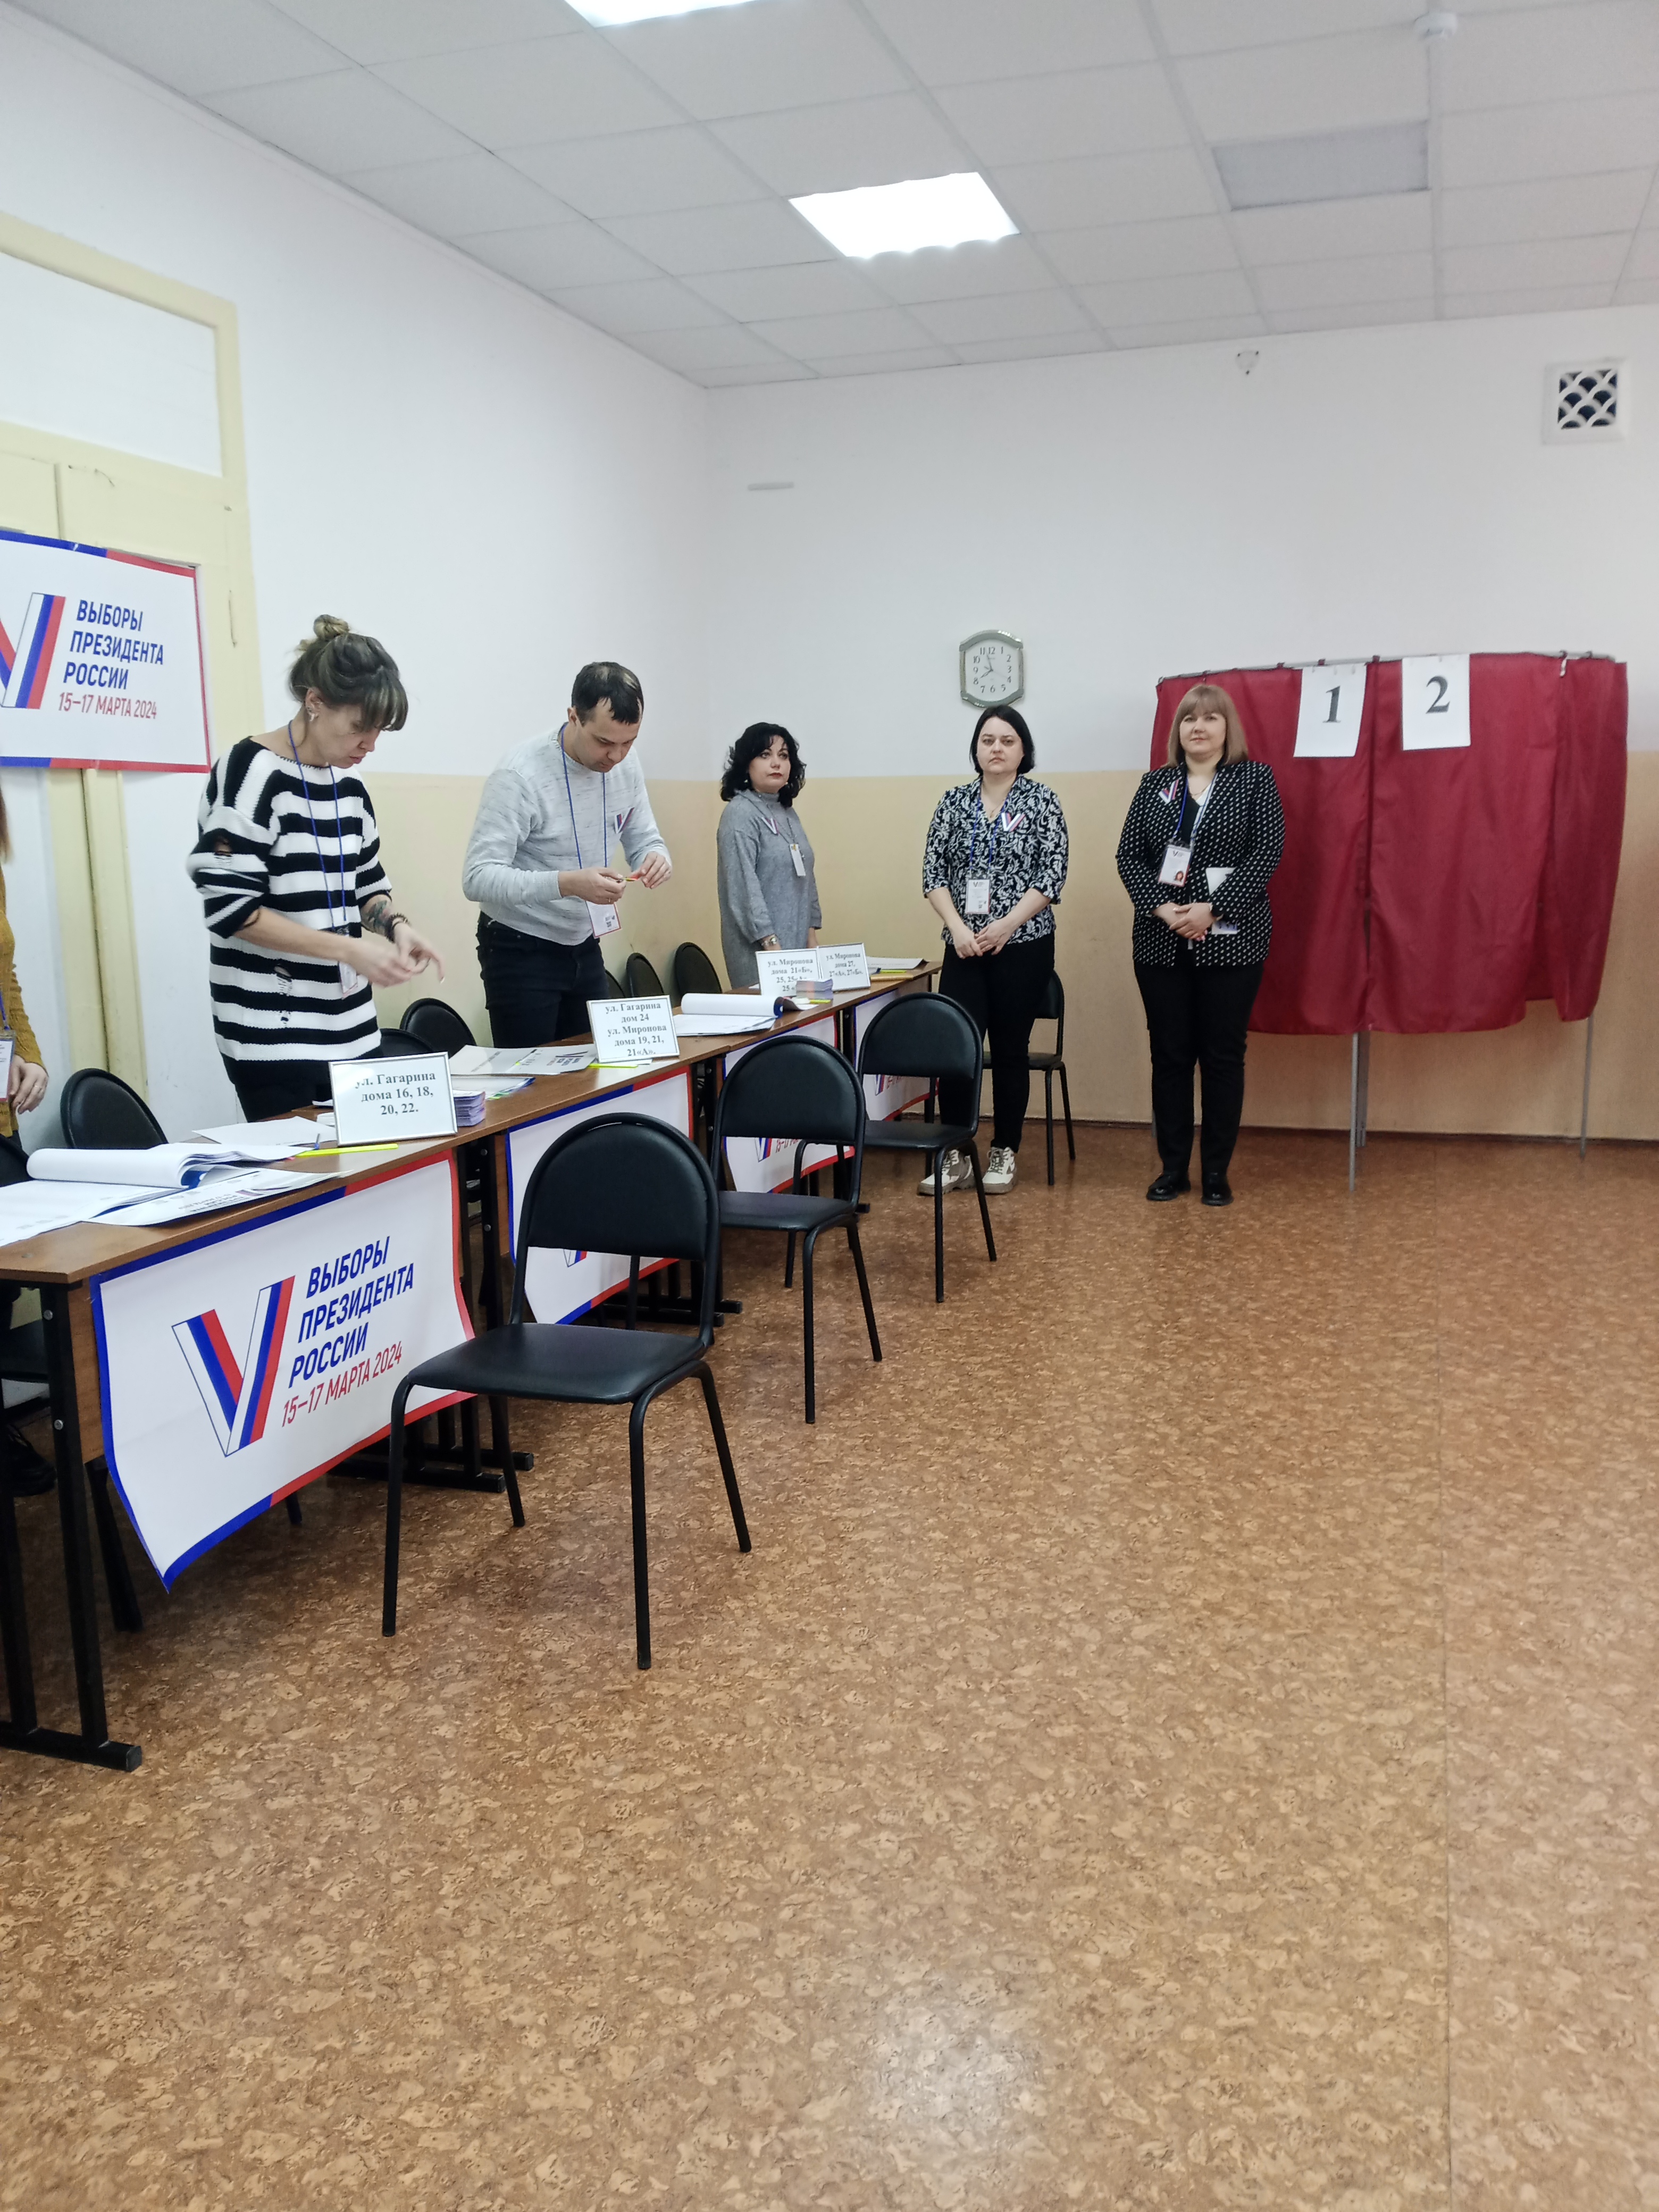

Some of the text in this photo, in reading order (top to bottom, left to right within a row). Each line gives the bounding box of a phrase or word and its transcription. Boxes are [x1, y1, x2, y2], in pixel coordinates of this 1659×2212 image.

[77, 600, 143, 631] ВЫБОРЫ
[70, 630, 164, 665] ПРЕЗИДЕНТА
[973, 655, 981, 664] 10
[1007, 654, 1011, 663] 2
[63, 661, 129, 690] РОССИИ
[980, 685, 985, 693] 7
[1426, 675, 1451, 714] 2
[96, 695, 131, 717] МАРТА
[133, 699, 157, 719] 2024
[1322, 686, 1340, 723] 1
[621, 1002, 661, 1011] Гагарина
[623, 1025, 666, 1035] Миронова
[653, 1035, 664, 1044] 21,
[355, 1073, 435, 1089] ул. Гагарина
[361, 1086, 433, 1102] дома 16, 18,
[381, 1103, 418, 1116] 20, 22.
[306, 1236, 390, 1299] ВЫБОРЫ
[298, 1262, 414, 1343] ПРЕЗИДЕНТА
[289, 1322, 368, 1388] РОССИИ
[325, 1358, 370, 1405] МАРТА
[373, 1340, 402, 1378] 2024
